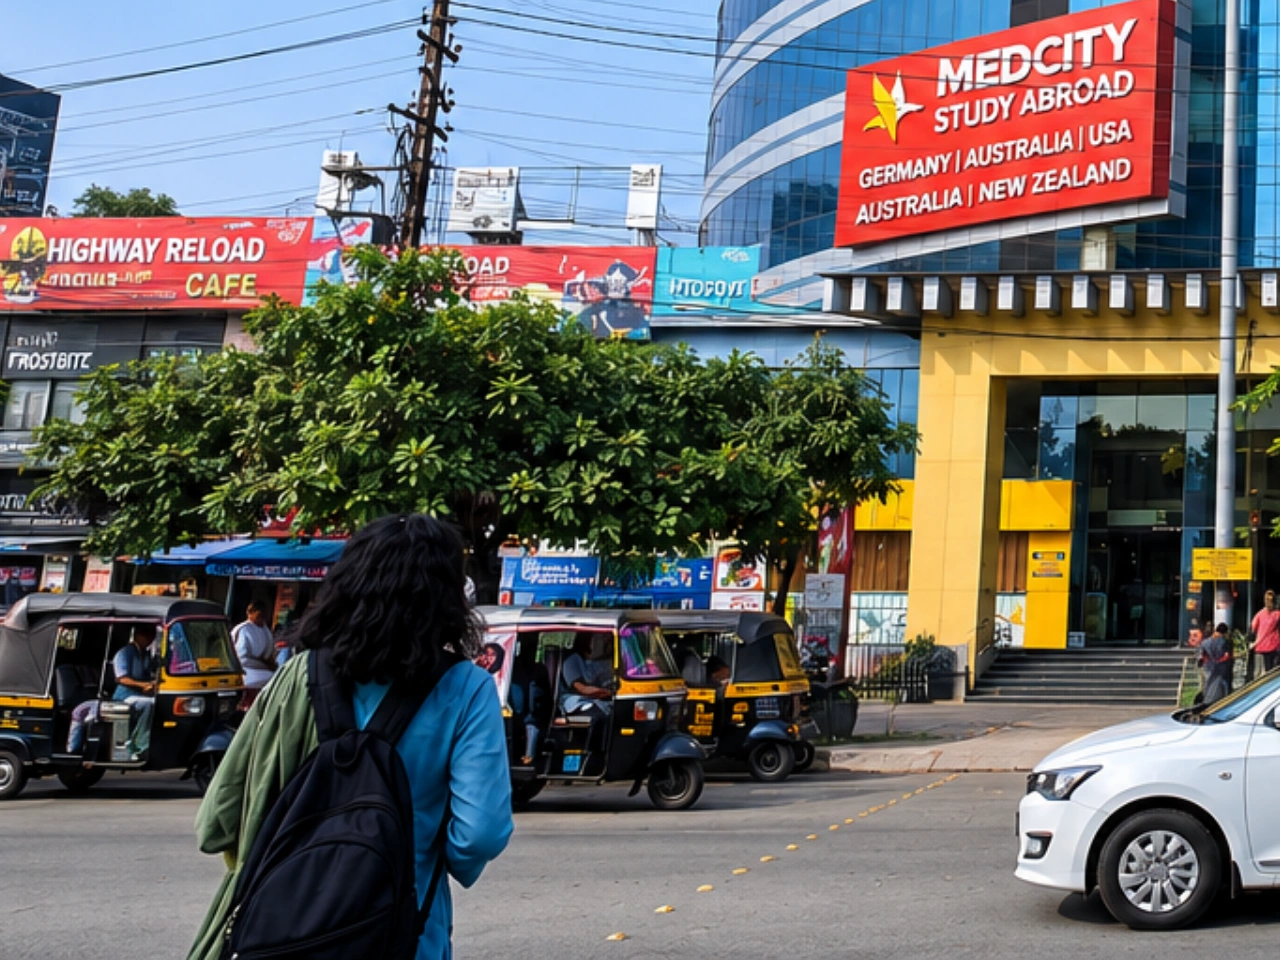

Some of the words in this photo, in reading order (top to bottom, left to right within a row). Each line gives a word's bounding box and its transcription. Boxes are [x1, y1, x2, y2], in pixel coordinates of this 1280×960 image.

[936, 18, 1138, 98] MEDCITY
[933, 92, 1016, 134] STUDY
[1019, 69, 1134, 117] ABROAD
[858, 152, 952, 189] GERMANY
[964, 128, 1074, 169] AUSTRALIA
[1088, 119, 1133, 147] USA
[854, 185, 964, 227] AUSTRALIA
[978, 173, 1027, 204] NEW
[1031, 157, 1132, 195] ZEALAND
[47, 237, 161, 264] HIGHWAY
[164, 236, 266, 264] RELOAD
[185, 272, 259, 298] CAFE
